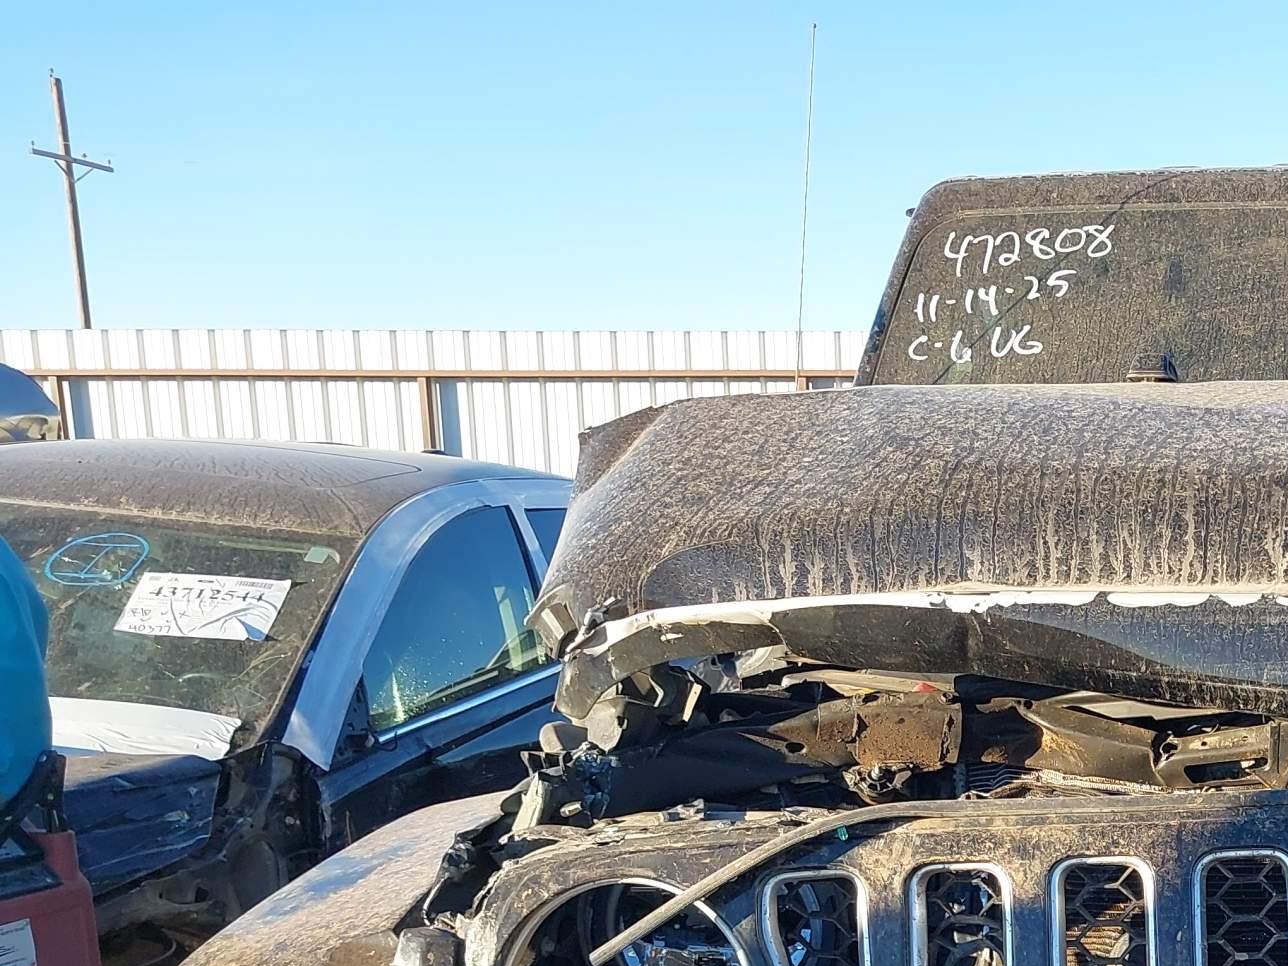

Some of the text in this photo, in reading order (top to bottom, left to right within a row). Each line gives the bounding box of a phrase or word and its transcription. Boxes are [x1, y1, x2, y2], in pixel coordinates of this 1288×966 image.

[944, 224, 1116, 277] 472808
[913, 269, 1077, 322] 11-14-25
[149, 585, 265, 603] 43712544
